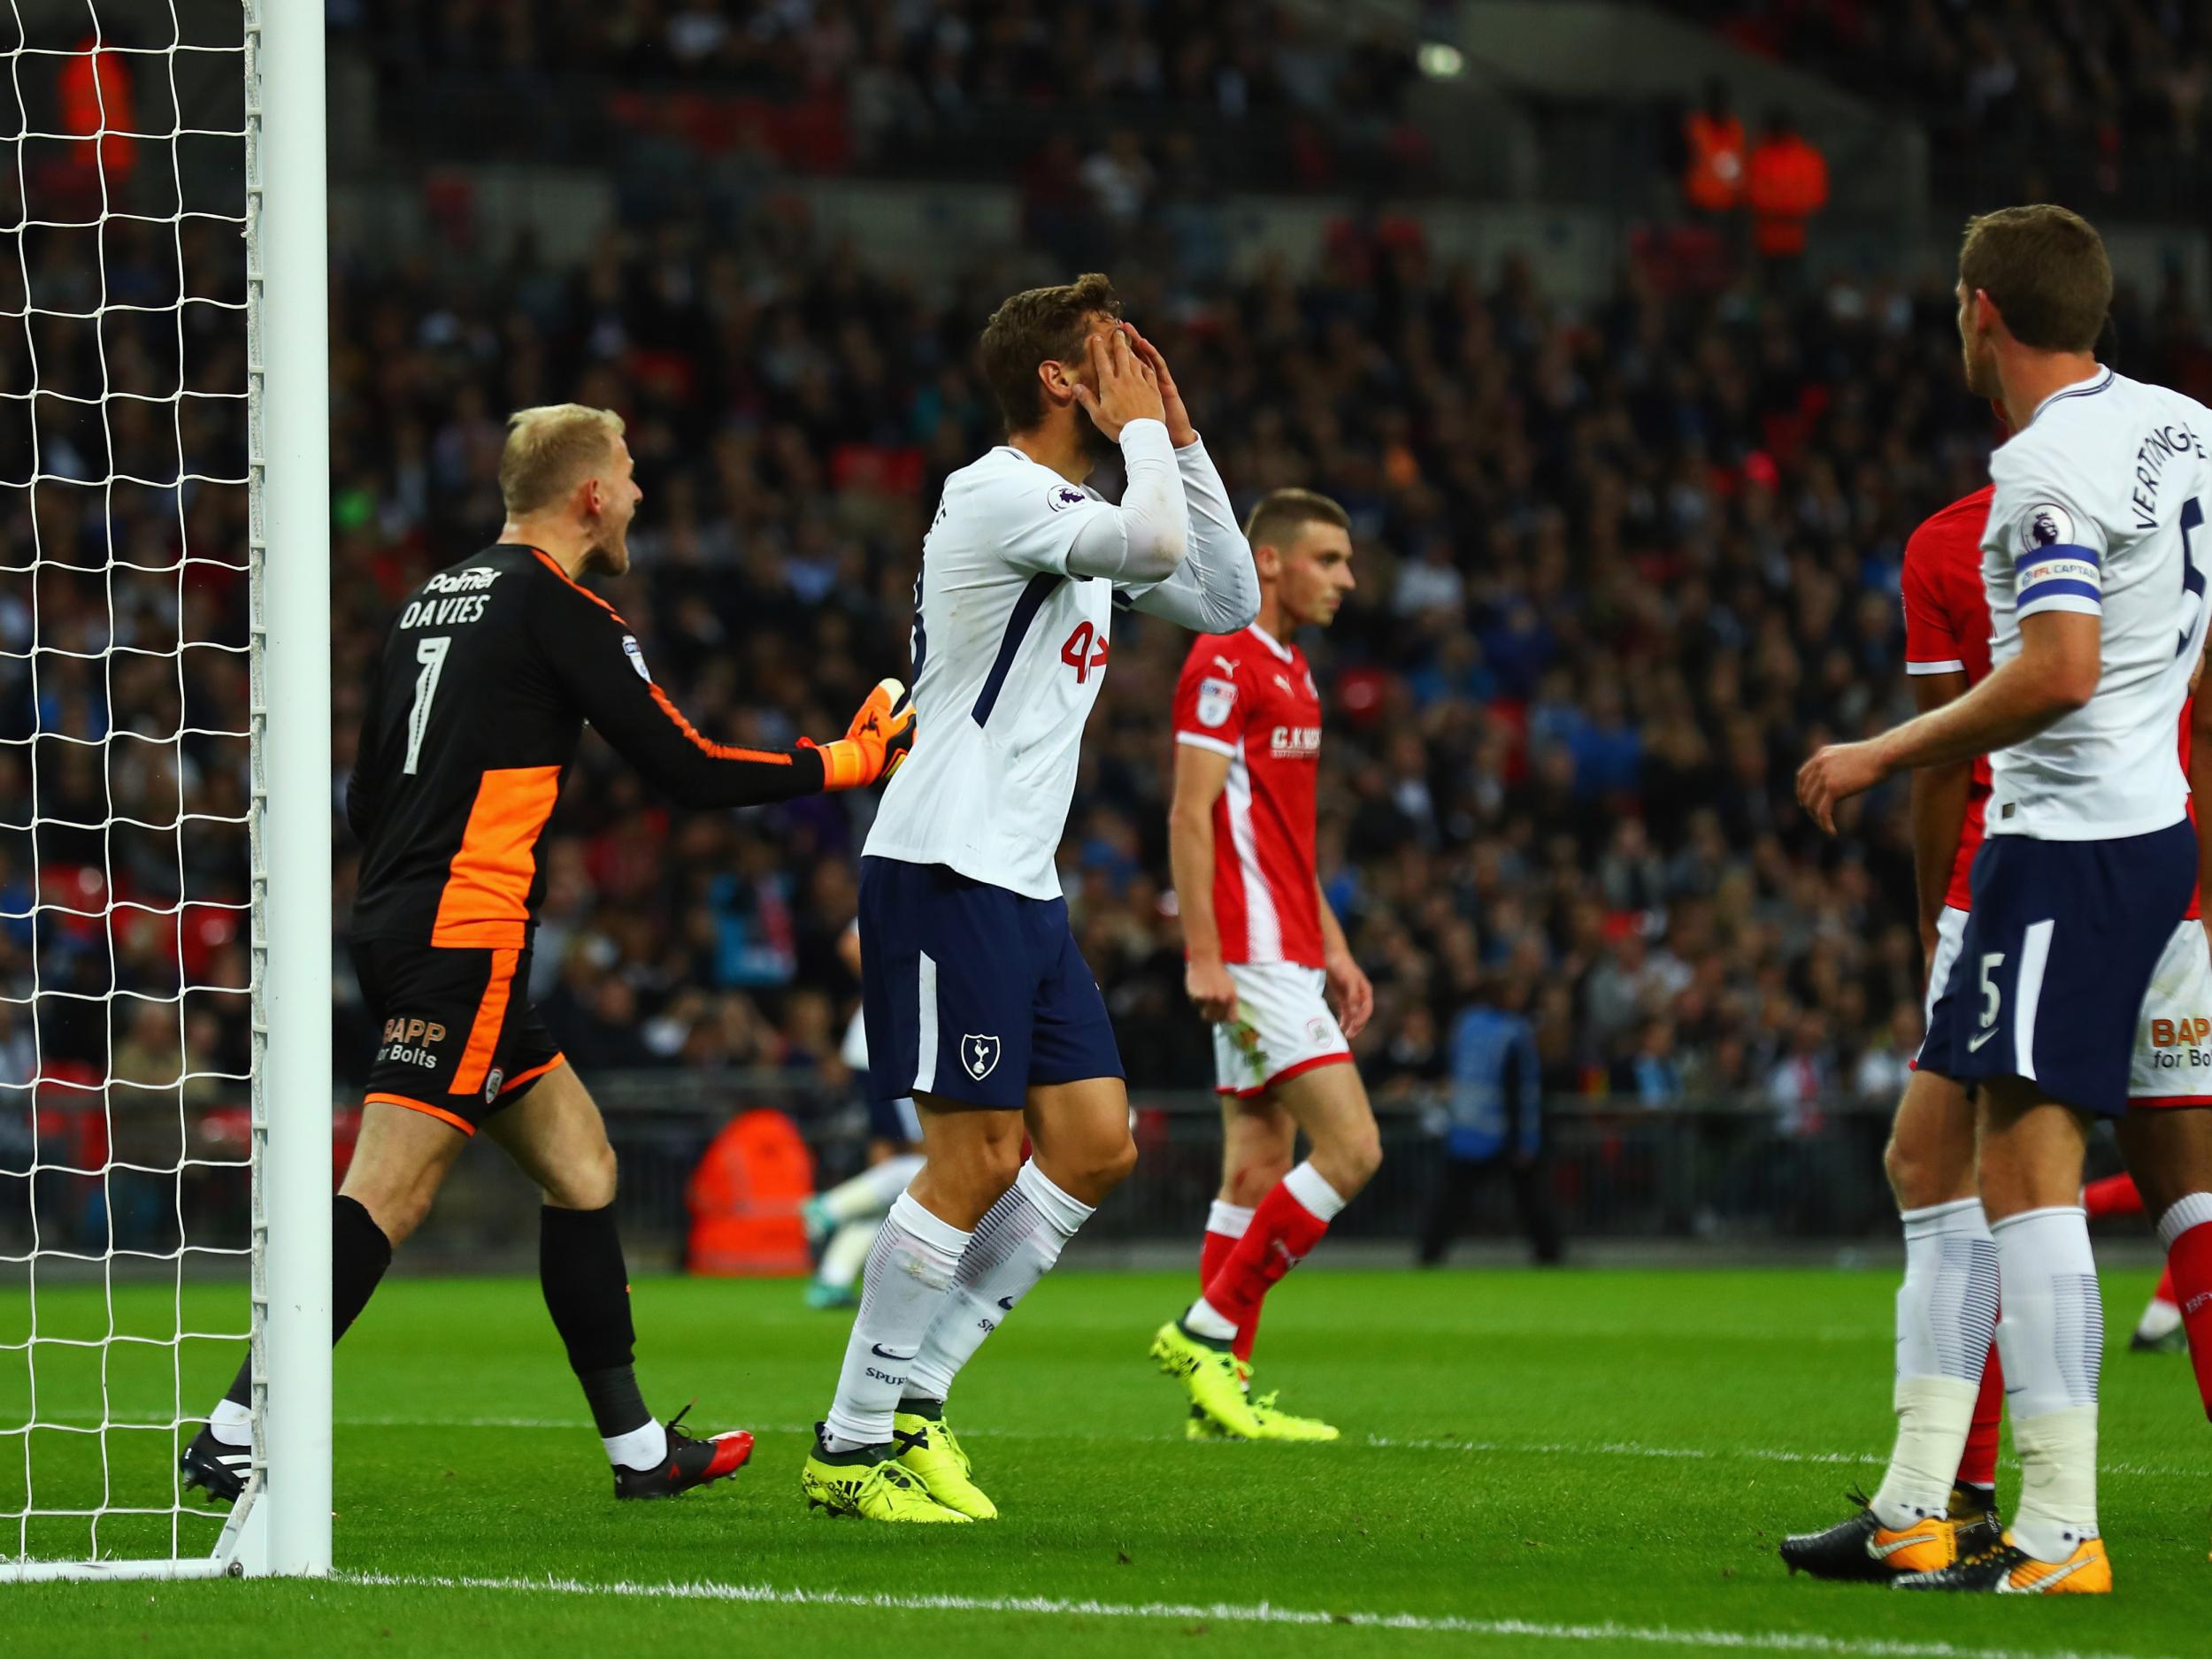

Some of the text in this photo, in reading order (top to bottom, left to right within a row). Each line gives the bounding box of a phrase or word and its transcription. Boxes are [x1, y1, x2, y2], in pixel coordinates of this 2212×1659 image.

[423, 567, 503, 595] Palmer
[400, 595, 491, 630] DAVIES
[403, 636, 452, 775] 1
[1978, 952, 2005, 1028] 5
[2151, 1018, 2212, 1048] BAP
[389, 1044, 438, 1069] Bolts
[2154, 1048, 2212, 1069] for Bo
